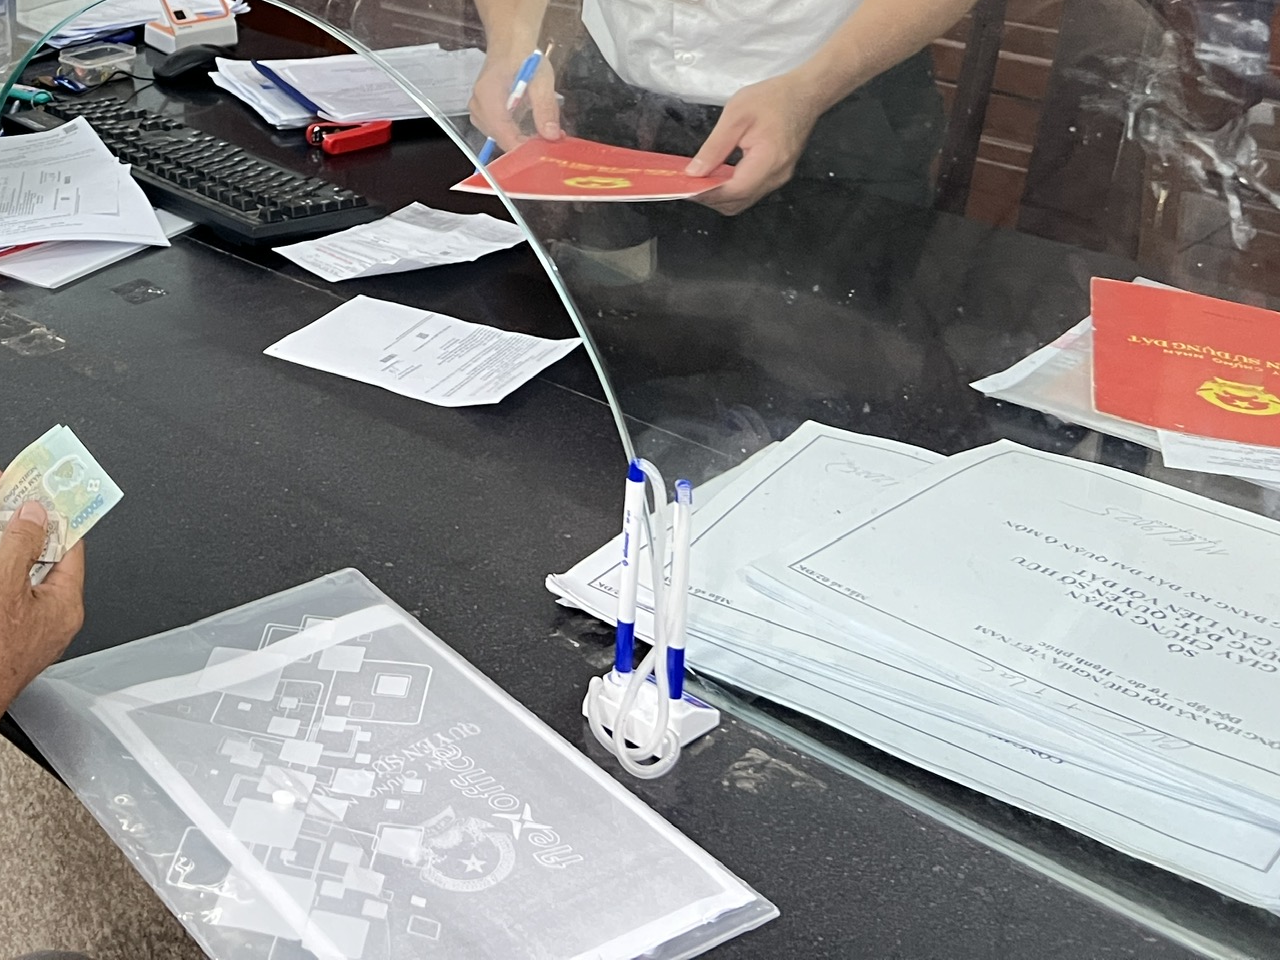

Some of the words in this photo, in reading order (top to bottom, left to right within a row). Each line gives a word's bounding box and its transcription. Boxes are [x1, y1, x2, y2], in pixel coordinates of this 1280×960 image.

[70, 493, 105, 530] 500000
[1058, 542, 1109, 563] QUẬN
[1111, 561, 1144, 576] ĐAI
[1064, 590, 1129, 617] NHẬN
[973, 624, 1013, 644] NAM
[1037, 641, 1075, 658] phúc
[1074, 656, 1114, 677] Hạnh
[1127, 678, 1147, 690] do
